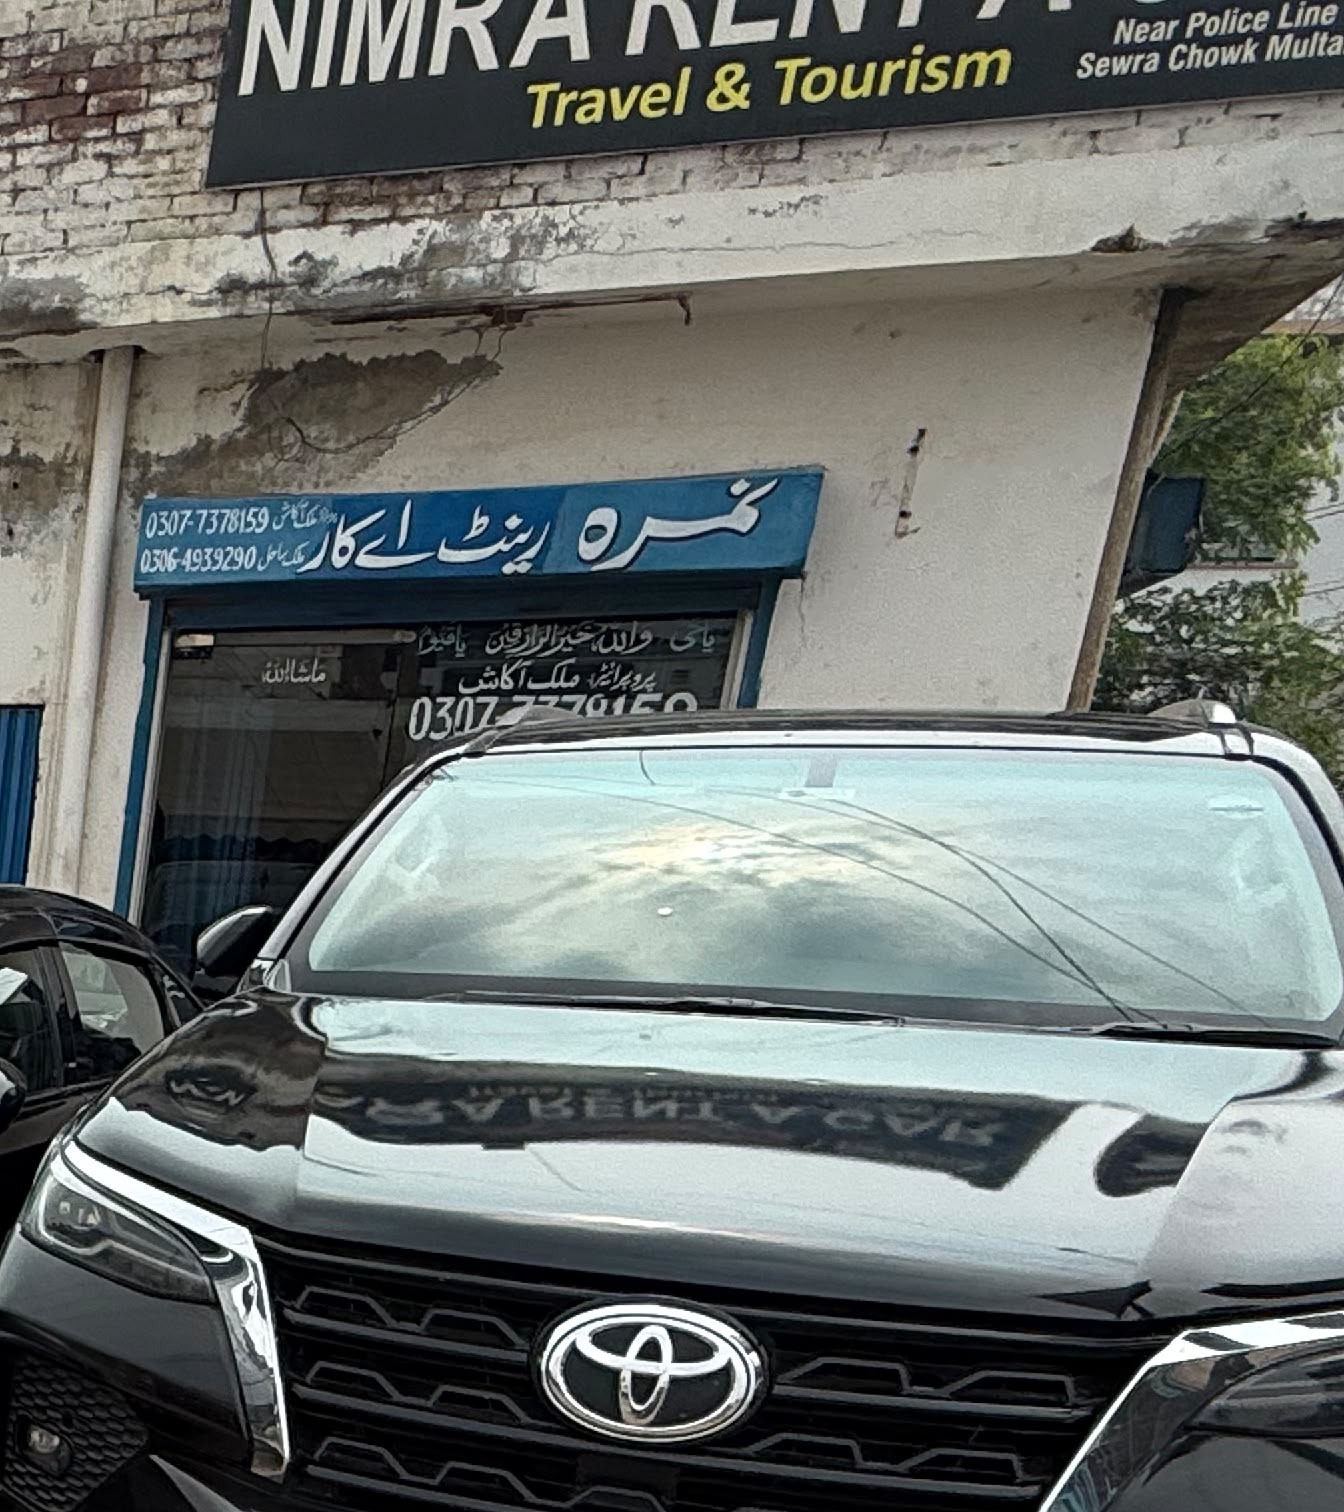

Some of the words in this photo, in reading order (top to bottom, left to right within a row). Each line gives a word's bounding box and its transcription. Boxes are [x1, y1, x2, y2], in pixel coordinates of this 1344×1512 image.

[1113, 17, 1180, 45] Near
[1185, 7, 1270, 39] Police
[1277, 0, 1340, 30] Line
[1076, 52, 1161, 80] Sewra
[1168, 38, 1260, 72] Chowk
[1264, 31, 1344, 62] Multa
[526, 66, 693, 129] Travel
[706, 62, 752, 113] &
[773, 44, 1013, 106] Tourism
[145, 506, 270, 539] 0307-7378159
[296, 508, 386, 575] کار
[438, 505, 551, 575] رینٹ
[578, 478, 780, 572] نمرہ
[140, 546, 257, 574] 0306-4939290
